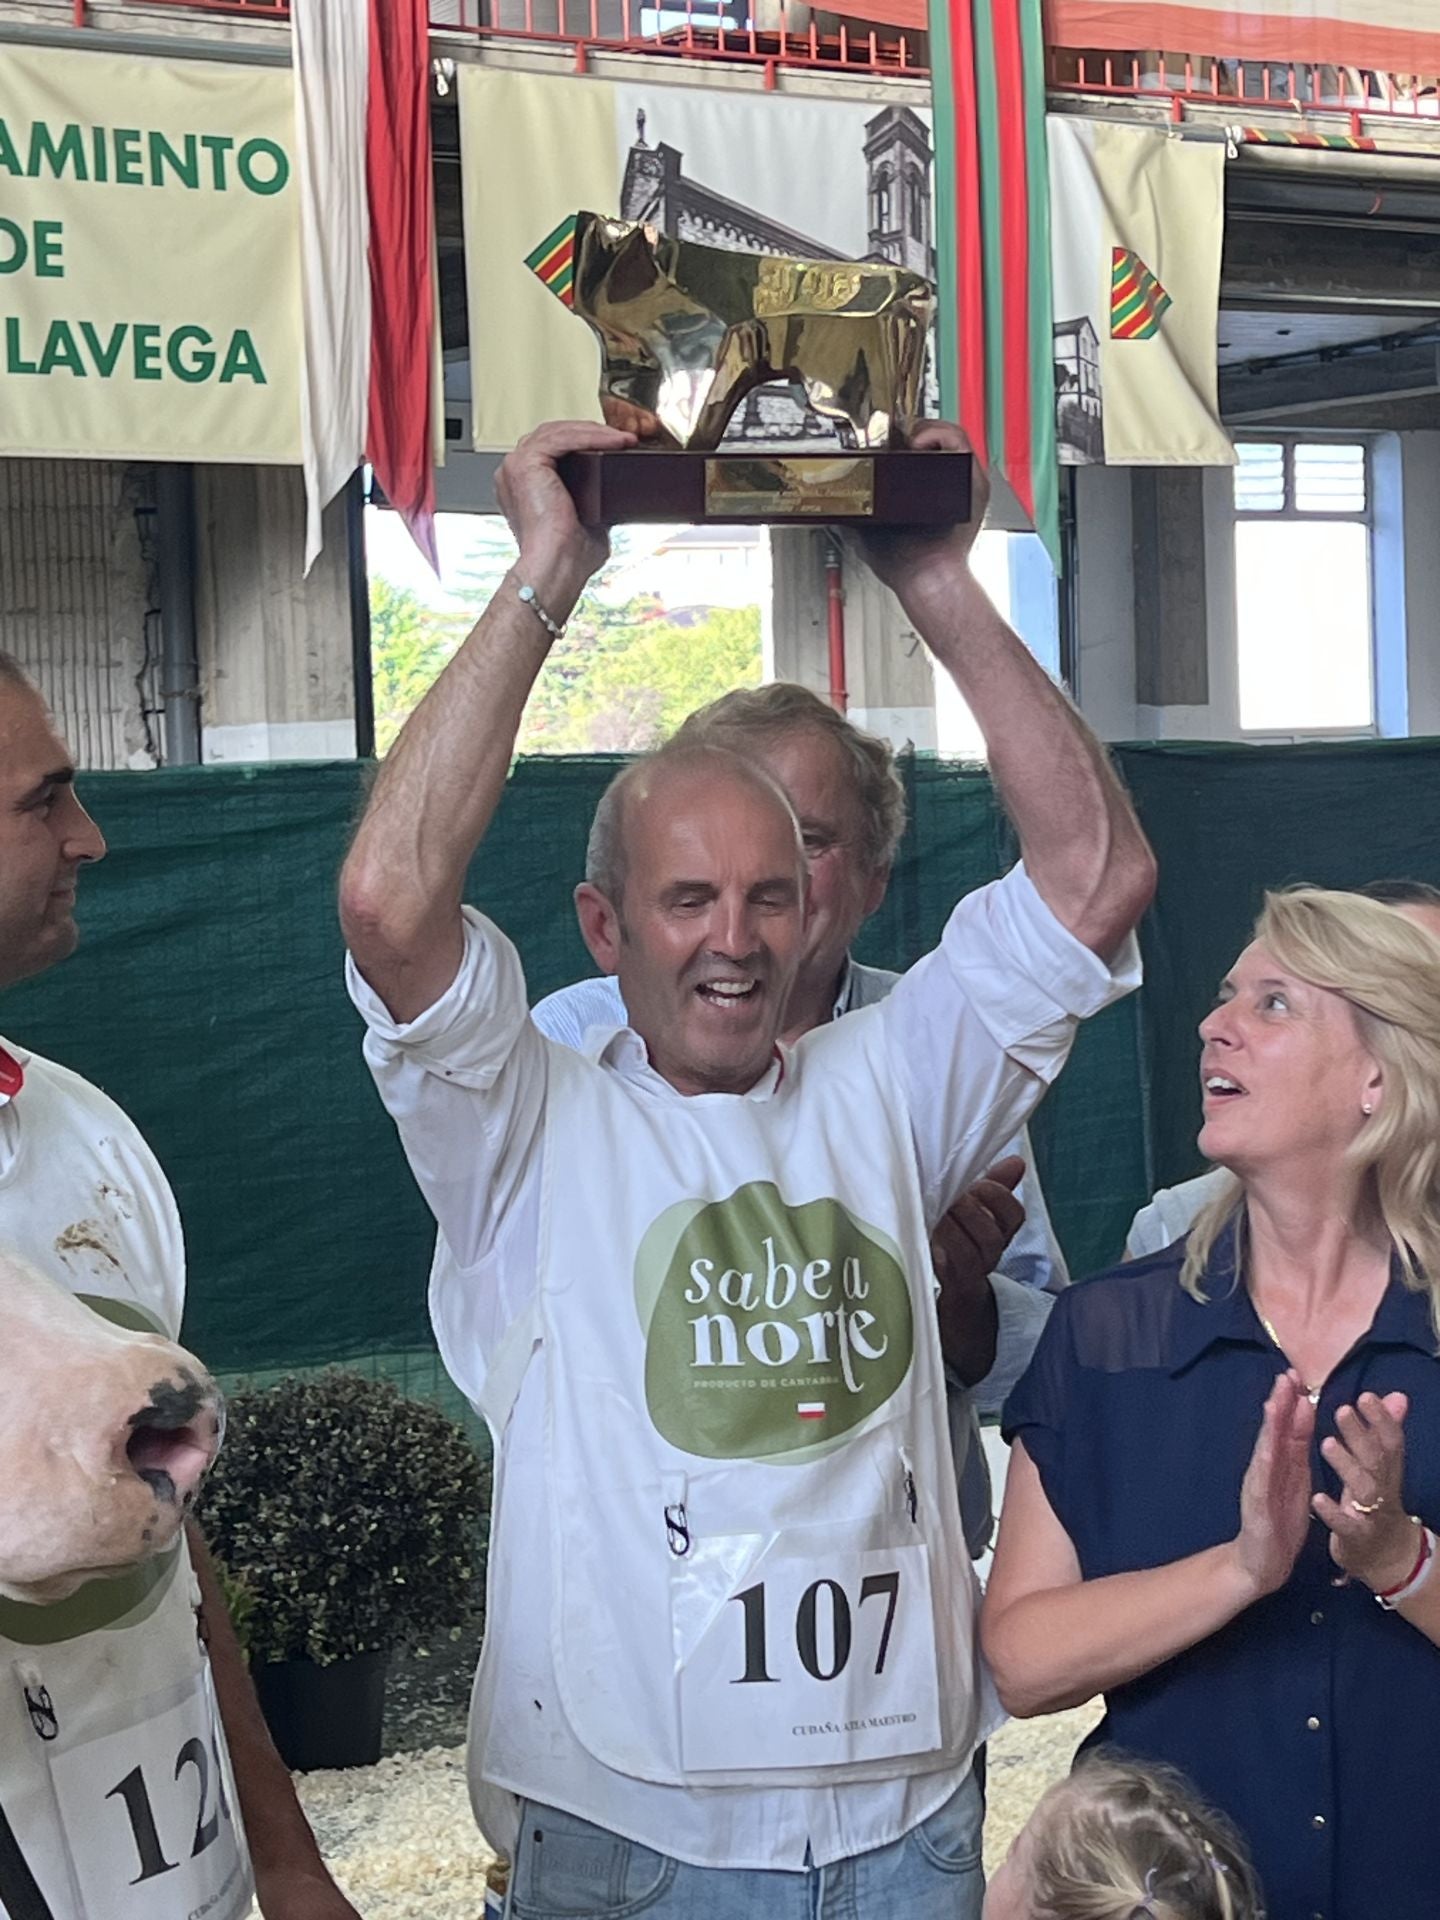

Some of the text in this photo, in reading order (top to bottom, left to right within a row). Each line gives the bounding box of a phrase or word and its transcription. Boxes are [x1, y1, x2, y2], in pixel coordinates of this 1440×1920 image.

[0, 217, 64, 278] DE
[5, 316, 268, 385] LAVEGA
[684, 1236, 833, 1311] sabe
[688, 1301, 889, 1393] norte
[693, 1378, 757, 1389] PRODUCTO
[760, 1379, 777, 1388] DE
[727, 1570, 901, 1685] 107
[867, 1713, 918, 1728] MAESTRO
[104, 1736, 231, 1886] 12
